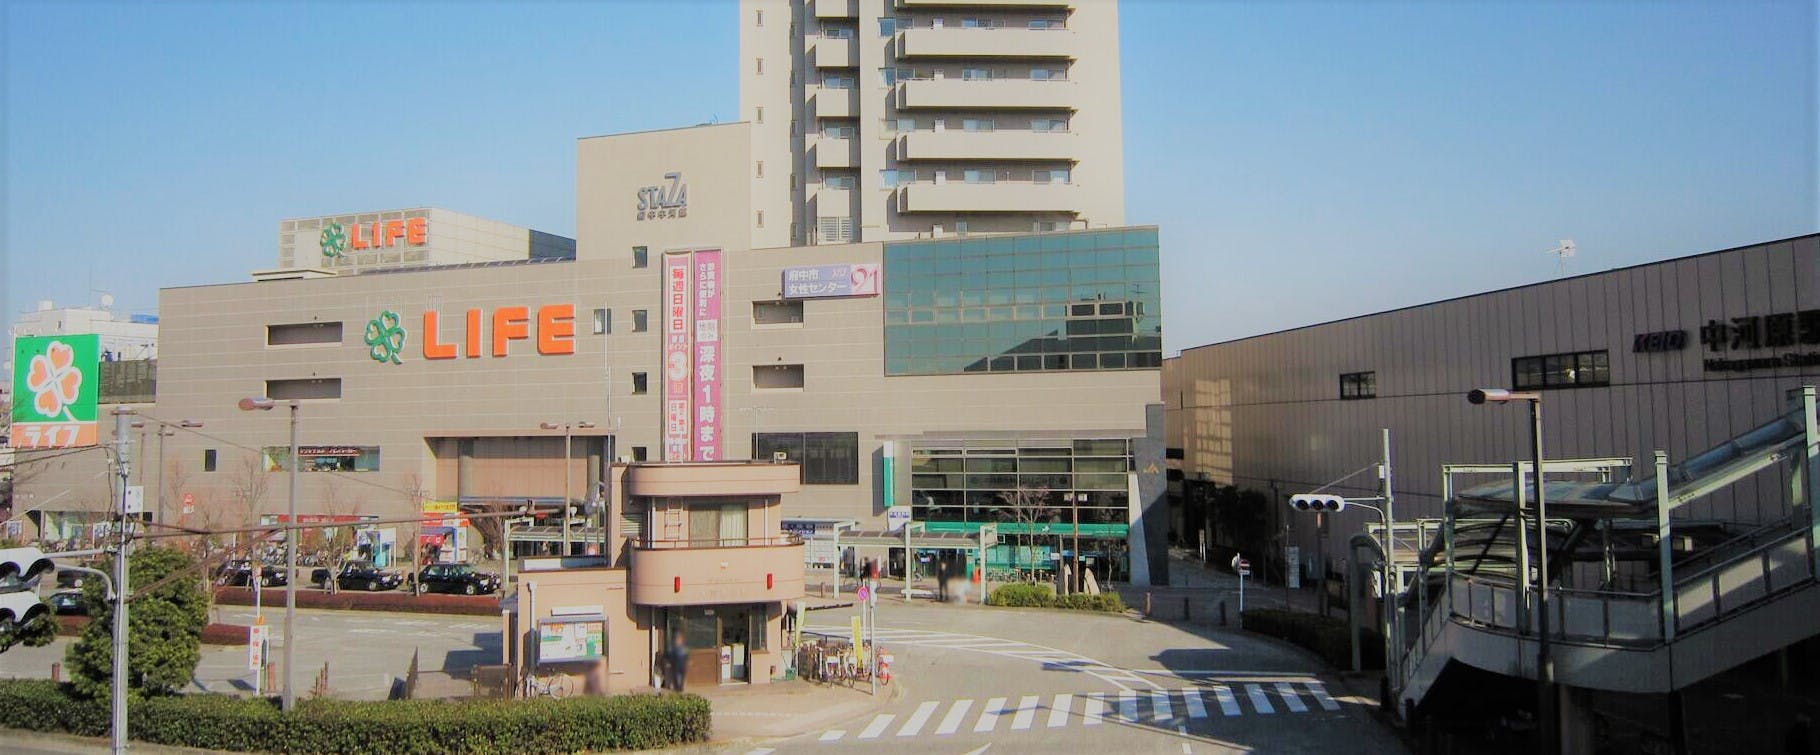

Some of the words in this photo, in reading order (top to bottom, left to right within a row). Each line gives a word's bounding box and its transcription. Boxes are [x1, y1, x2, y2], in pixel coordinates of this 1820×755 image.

[351, 217, 426, 250] LIFE
[788, 283, 846, 295] 女性センター
[789, 268, 819, 282] 府中市
[673, 268, 684, 331] 毎週日曜日
[423, 304, 575, 360] LIFE
[669, 351, 688, 381] 3
[25, 425, 81, 449] ライフ
